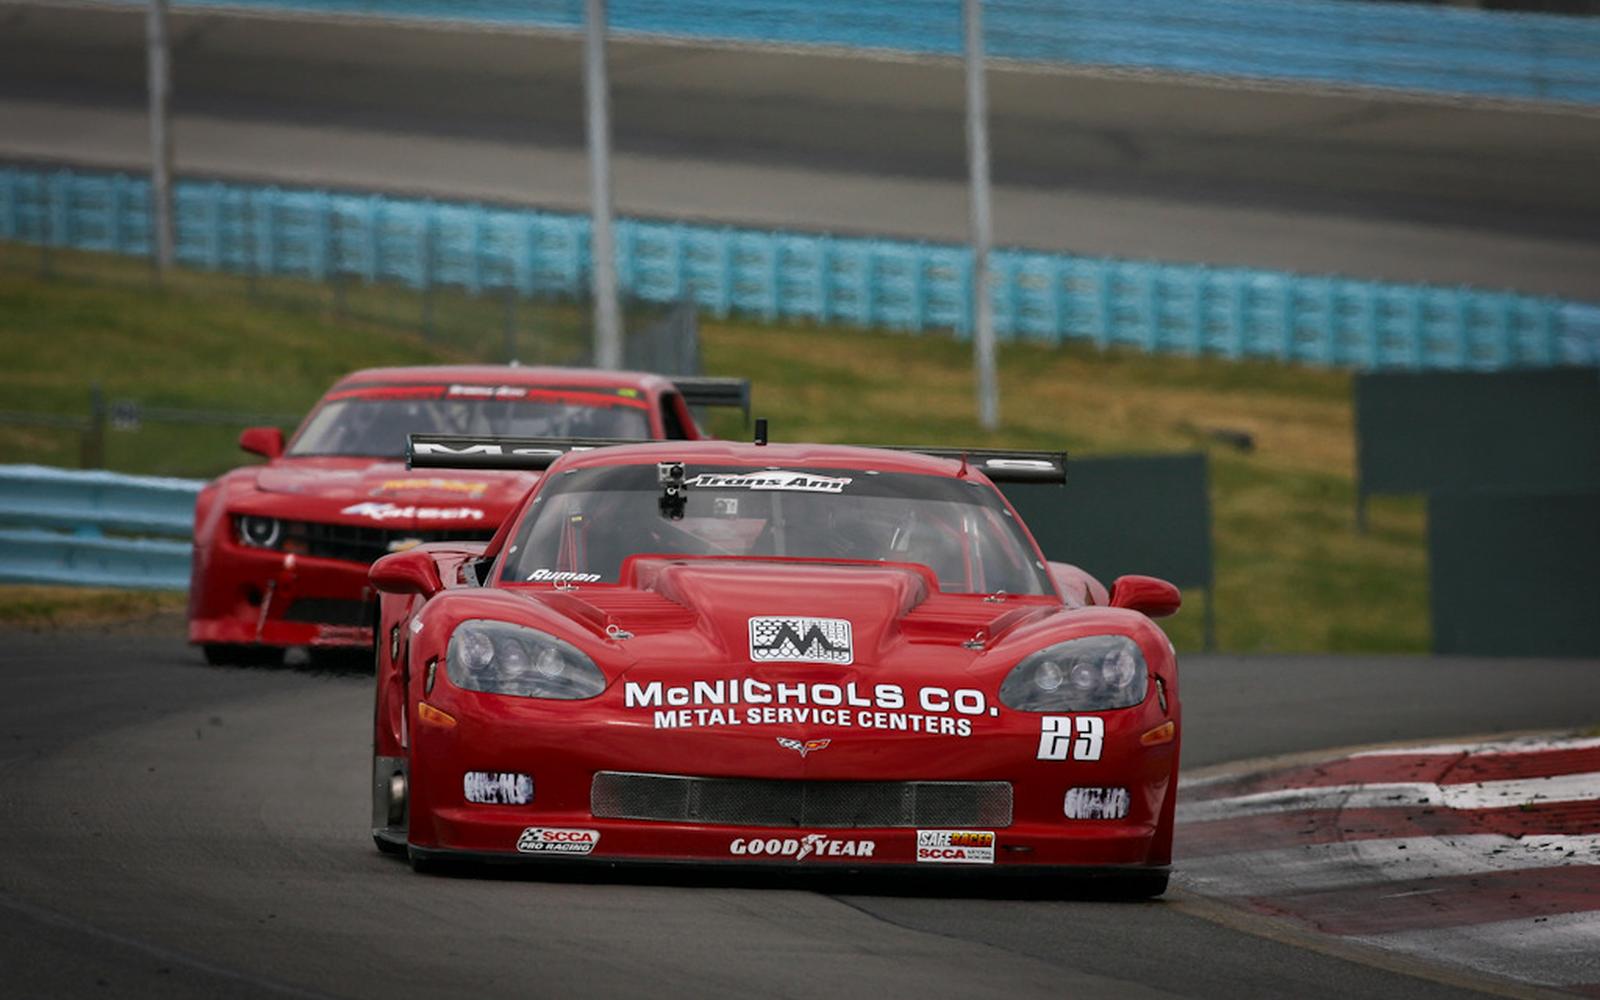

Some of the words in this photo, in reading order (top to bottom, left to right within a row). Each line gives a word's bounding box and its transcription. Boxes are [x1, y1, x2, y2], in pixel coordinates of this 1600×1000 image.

[697, 474, 783, 487] Trans
[783, 477, 844, 490] Am
[526, 568, 602, 583] Ruman
[624, 677, 905, 709] McNICHOLS
[918, 686, 998, 717] CO.
[654, 707, 741, 730] METAL
[746, 706, 852, 726] SERVICE
[856, 710, 973, 737] CENTERS
[1036, 715, 1105, 761] 23
[543, 831, 593, 843] SCCA
[519, 841, 543, 850] PRO
[544, 842, 591, 851] RACING
[918, 848, 966, 860] SCCA
